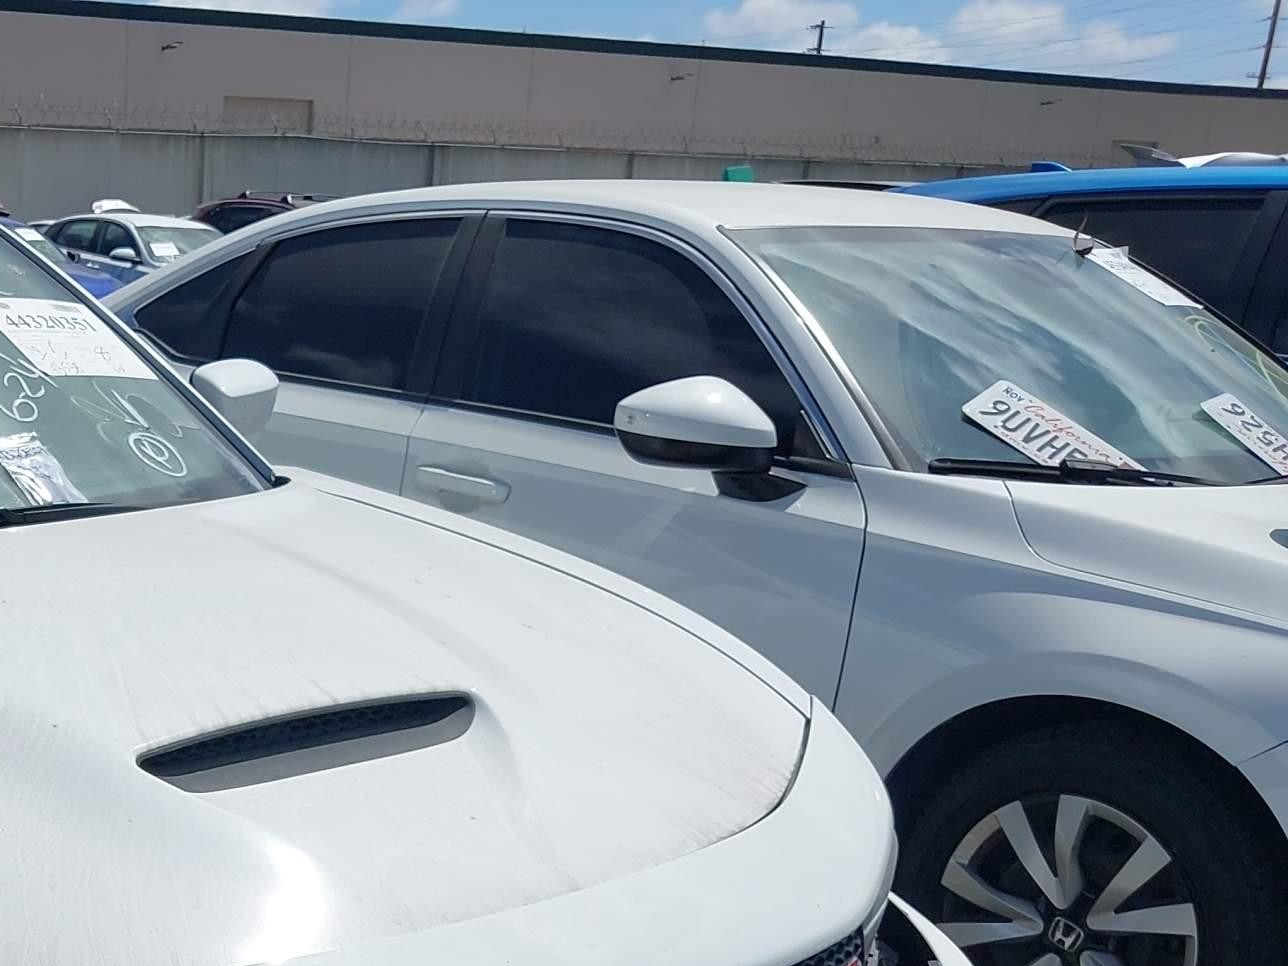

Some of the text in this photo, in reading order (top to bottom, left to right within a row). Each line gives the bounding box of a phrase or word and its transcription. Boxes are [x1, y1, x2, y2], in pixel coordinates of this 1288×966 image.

[5, 313, 97, 333] 44320351
[1002, 386, 1025, 402] NOV
[1024, 404, 1111, 462] California
